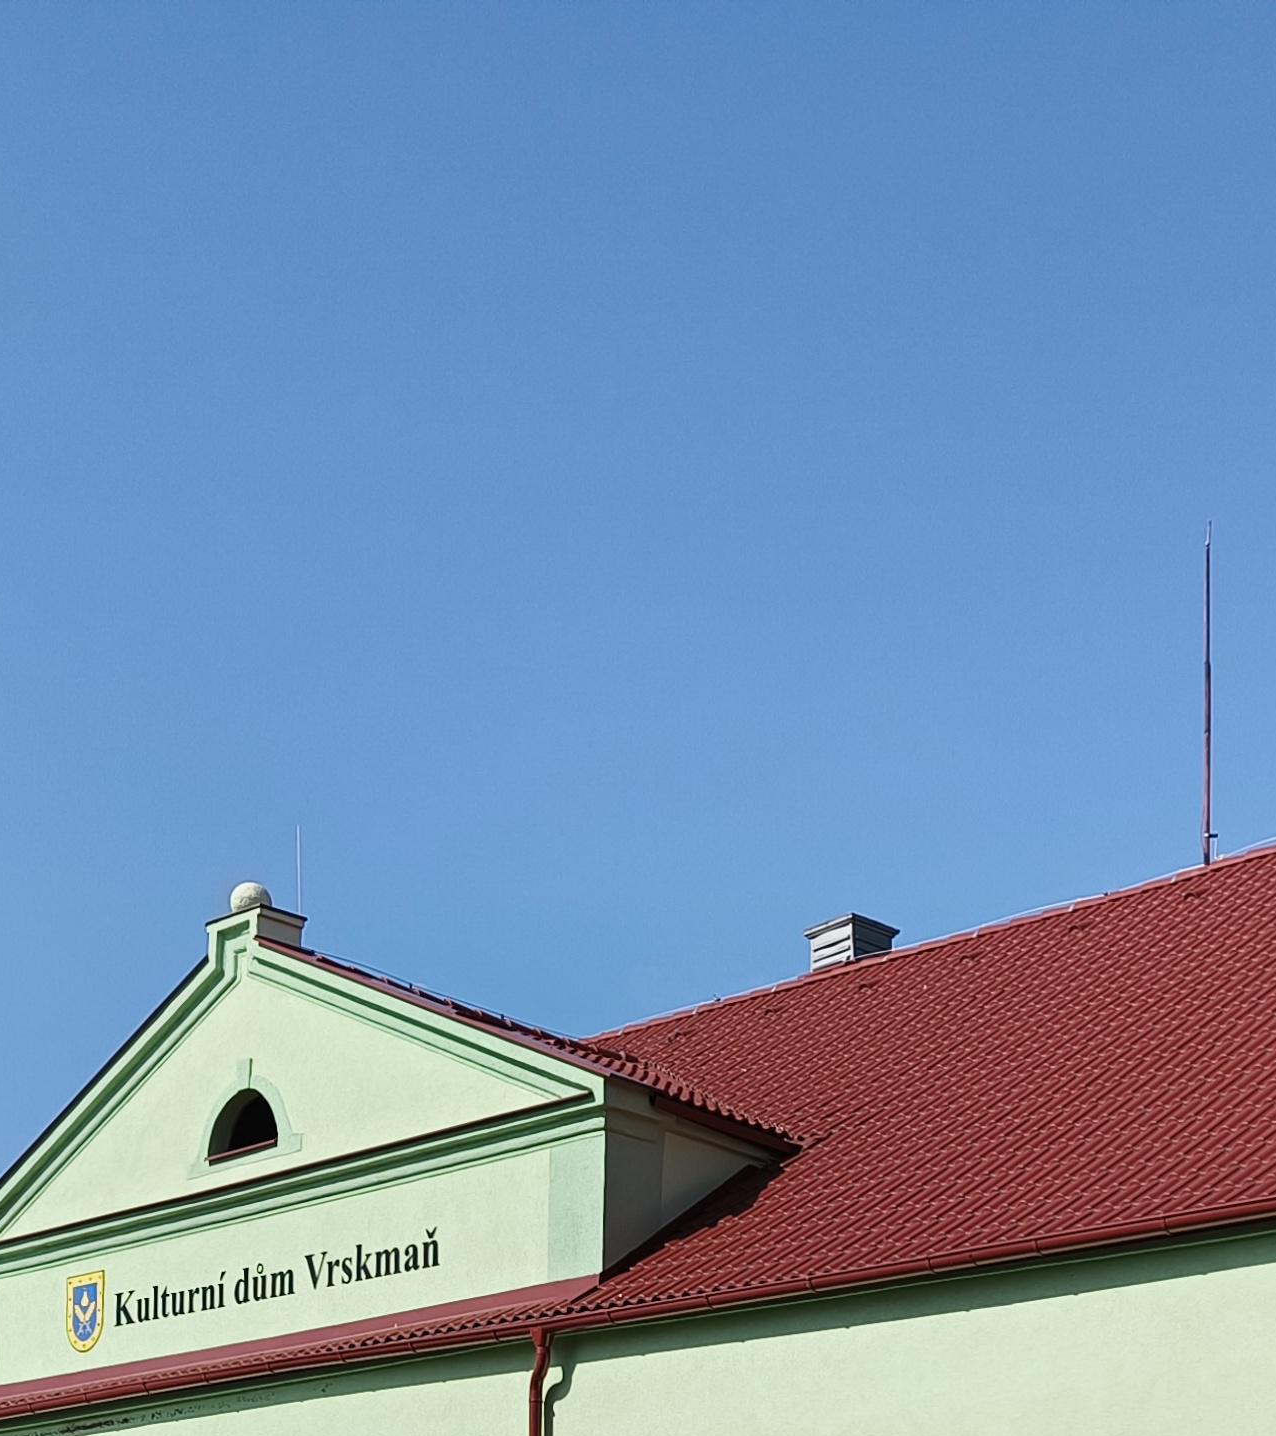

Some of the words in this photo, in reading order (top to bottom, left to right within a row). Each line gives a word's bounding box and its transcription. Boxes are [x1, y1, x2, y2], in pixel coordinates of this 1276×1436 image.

[114, 1271, 227, 1327] Kulturní
[234, 1264, 295, 1304] dům
[305, 1227, 440, 1290] Vrskmaň
